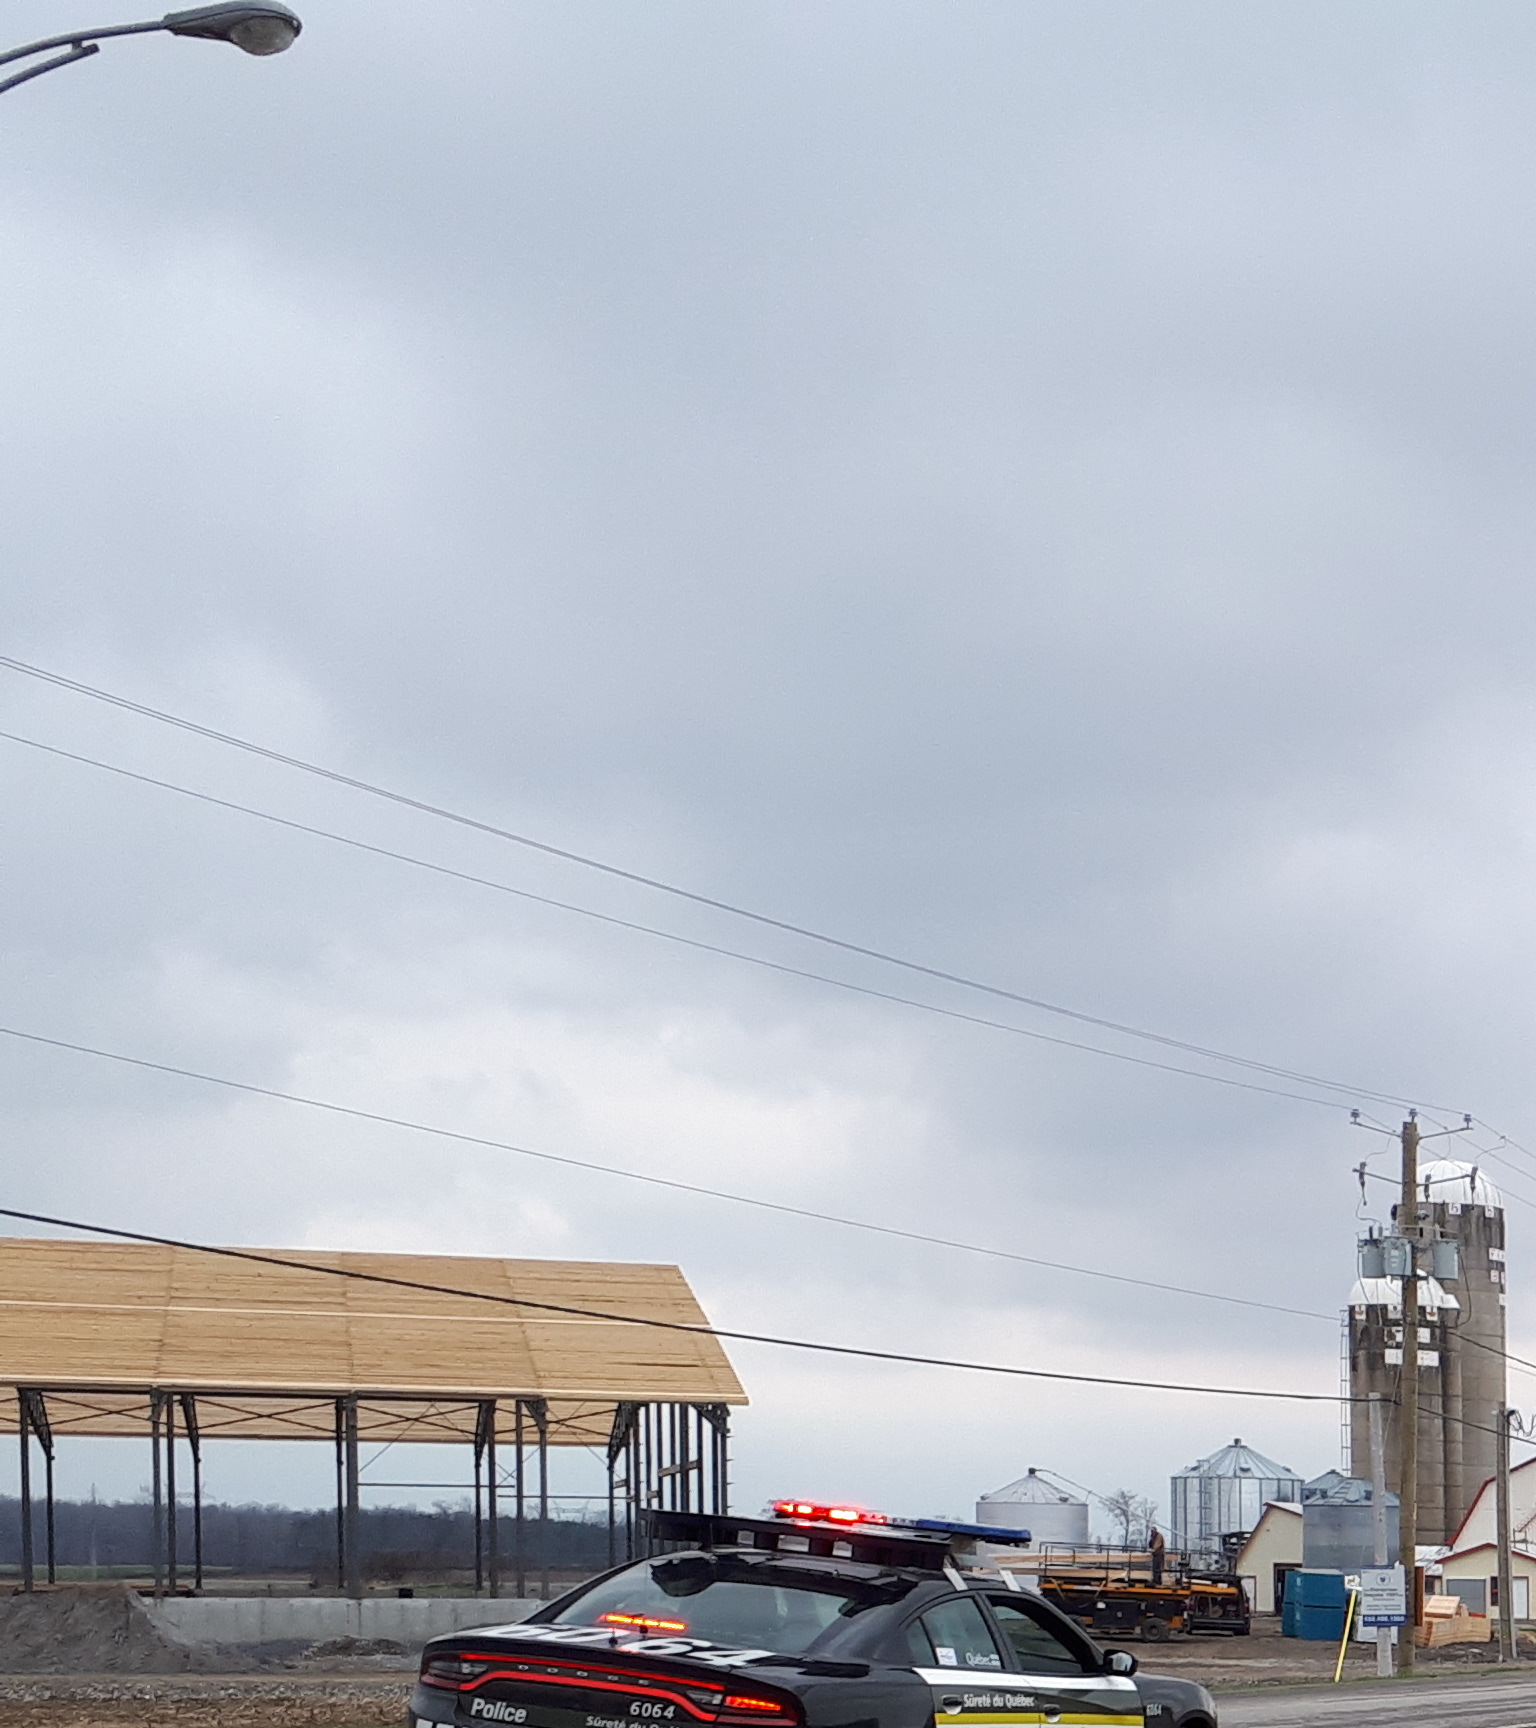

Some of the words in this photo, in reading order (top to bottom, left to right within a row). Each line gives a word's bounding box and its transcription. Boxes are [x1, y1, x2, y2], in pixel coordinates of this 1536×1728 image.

[964, 1693, 991, 1707] Sûreté
[993, 1694, 1004, 1707] du
[1006, 1693, 1035, 1709] Québec
[470, 1697, 527, 1723] Police
[630, 1702, 676, 1719] 6064
